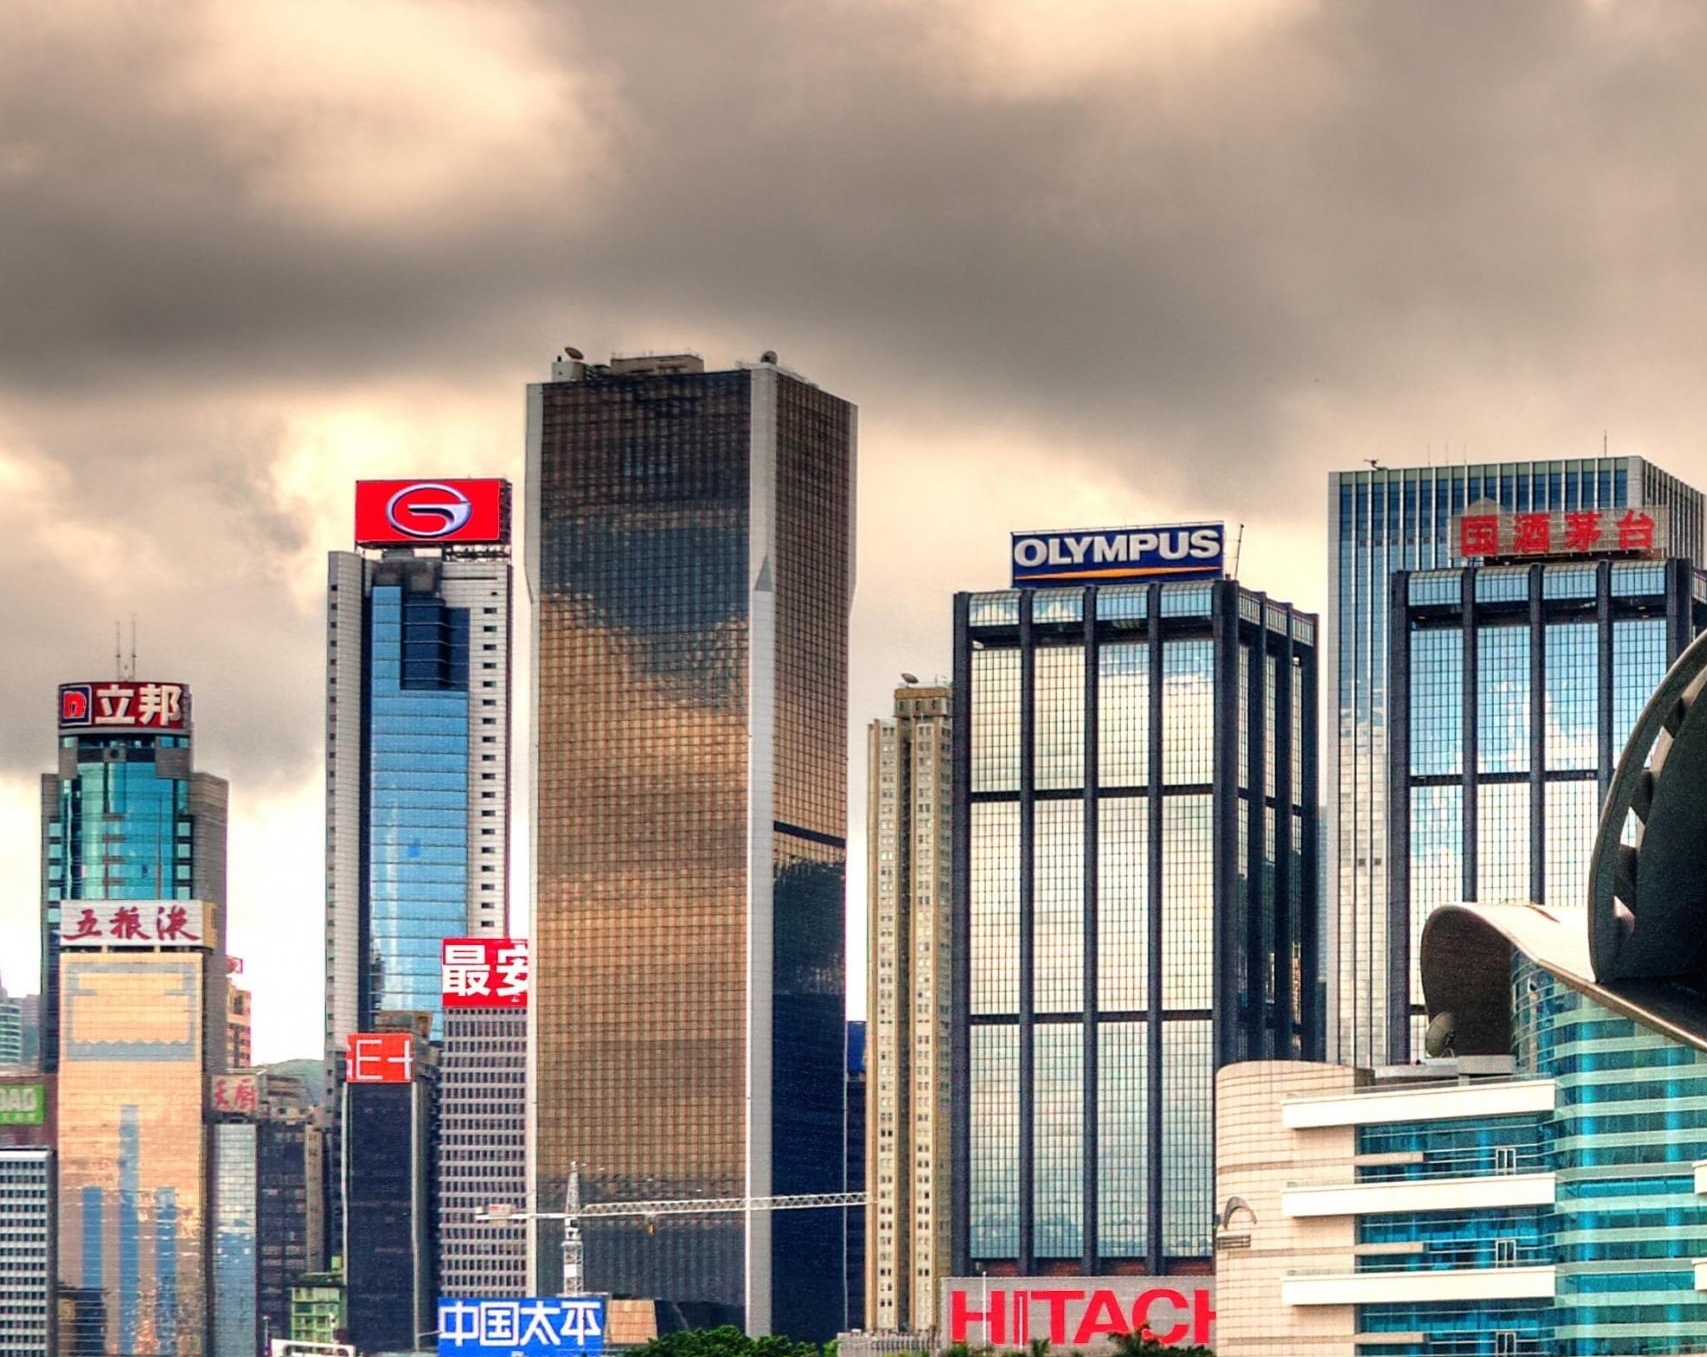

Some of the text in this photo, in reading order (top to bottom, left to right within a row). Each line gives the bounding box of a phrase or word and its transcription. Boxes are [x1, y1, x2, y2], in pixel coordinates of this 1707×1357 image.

[1014, 529, 1221, 567] OLYMPUS
[1461, 508, 1655, 557] 国酒茅台
[95, 683, 183, 727] 立邦
[62, 904, 202, 941] 五粮液
[438, 1300, 602, 1347] 中国太平
